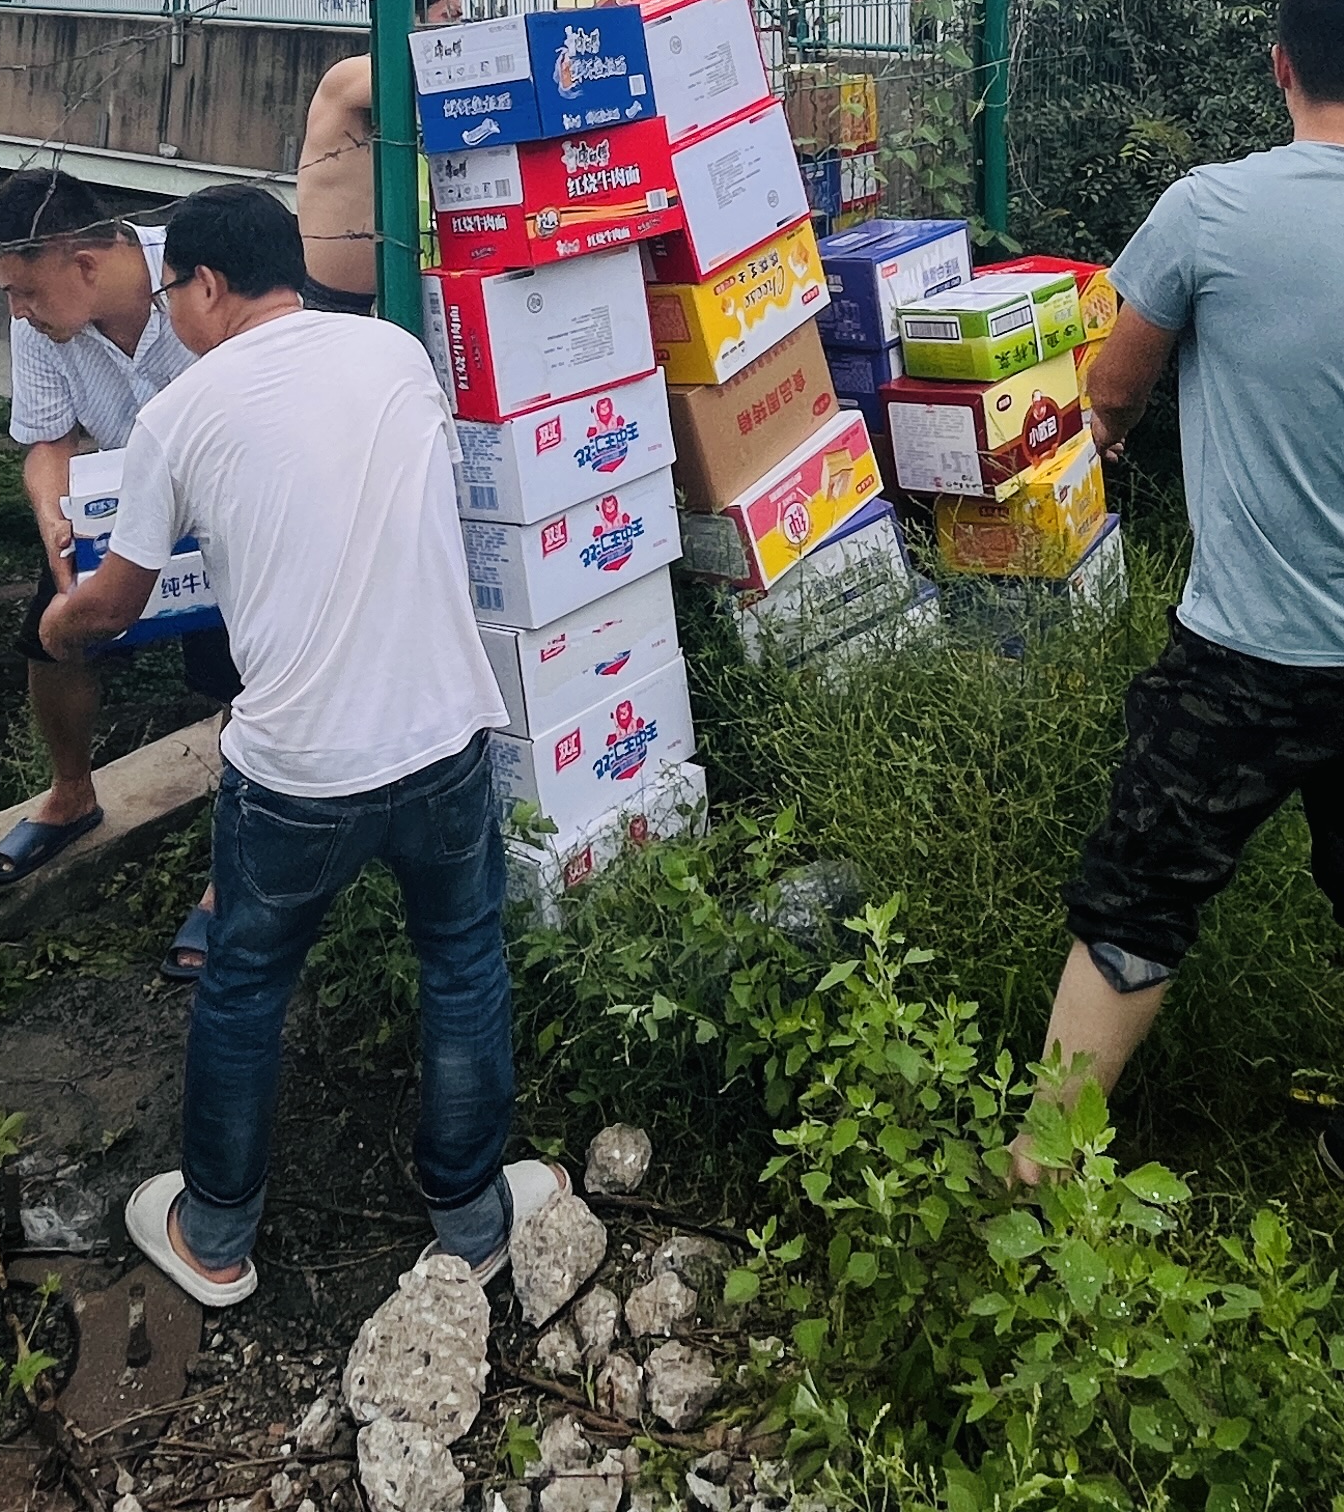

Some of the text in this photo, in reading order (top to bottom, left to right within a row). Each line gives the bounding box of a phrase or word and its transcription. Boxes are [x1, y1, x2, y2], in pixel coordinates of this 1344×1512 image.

[567, 164, 641, 198] 红烧牛肉面
[452, 213, 507, 233] 红烧牛肉面
[736, 368, 807, 436] 食品周转箱
[538, 420, 560, 445] 双汇
[1029, 416, 1058, 448] 小欧包
[543, 519, 566, 544] 双汇
[558, 734, 580, 761] 双汇
